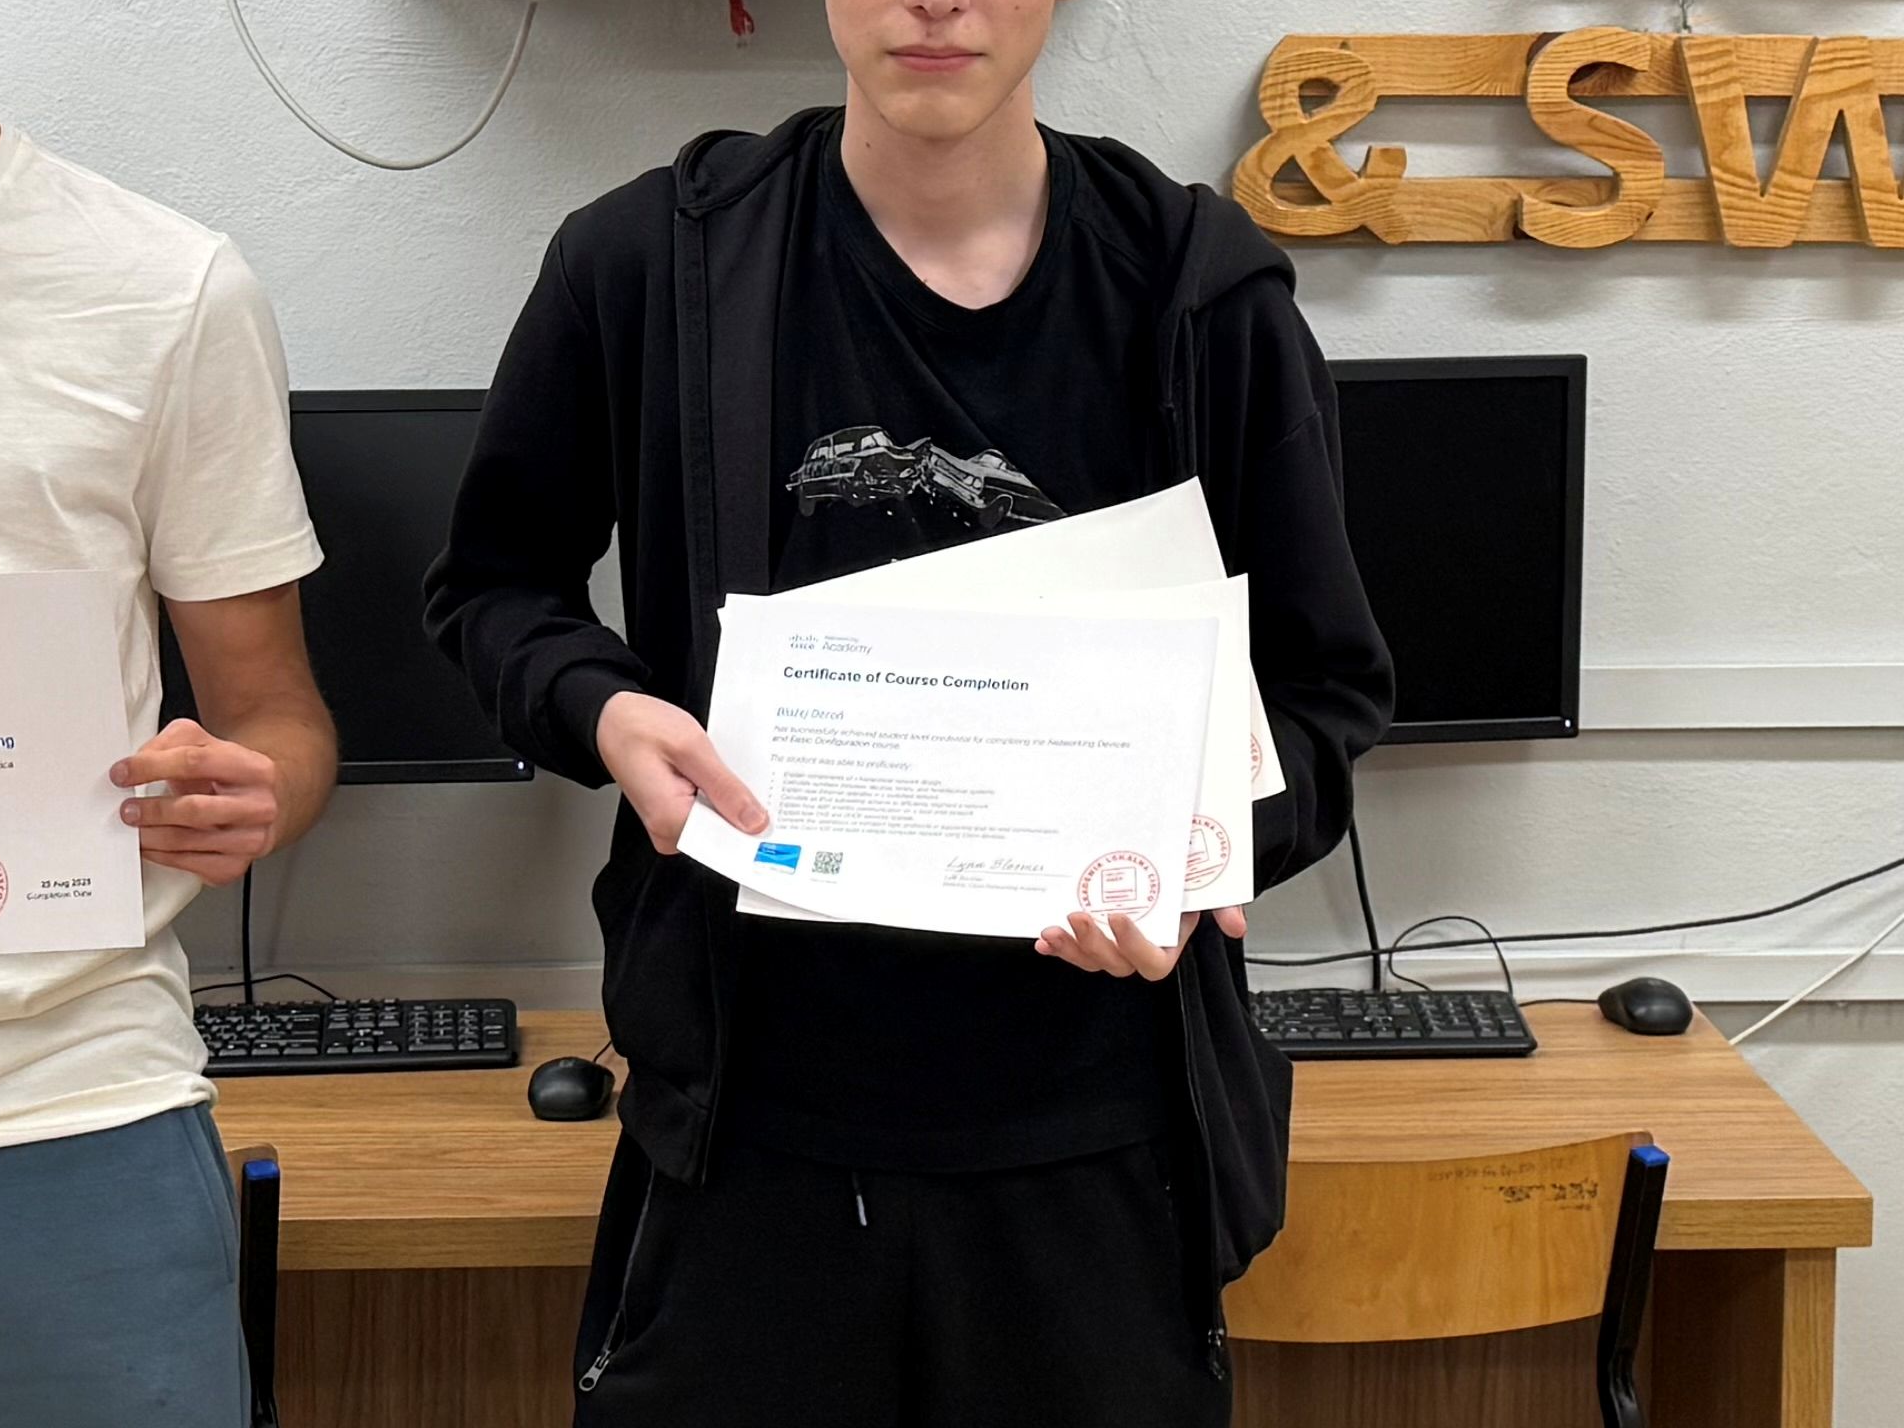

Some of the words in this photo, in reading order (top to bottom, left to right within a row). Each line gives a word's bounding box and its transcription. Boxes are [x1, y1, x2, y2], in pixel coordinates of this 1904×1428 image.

[1232, 38, 1406, 244] &
[783, 666, 861, 682] Certificate
[865, 671, 881, 683] of
[884, 672, 939, 687] Course
[942, 675, 1030, 691] Completion
